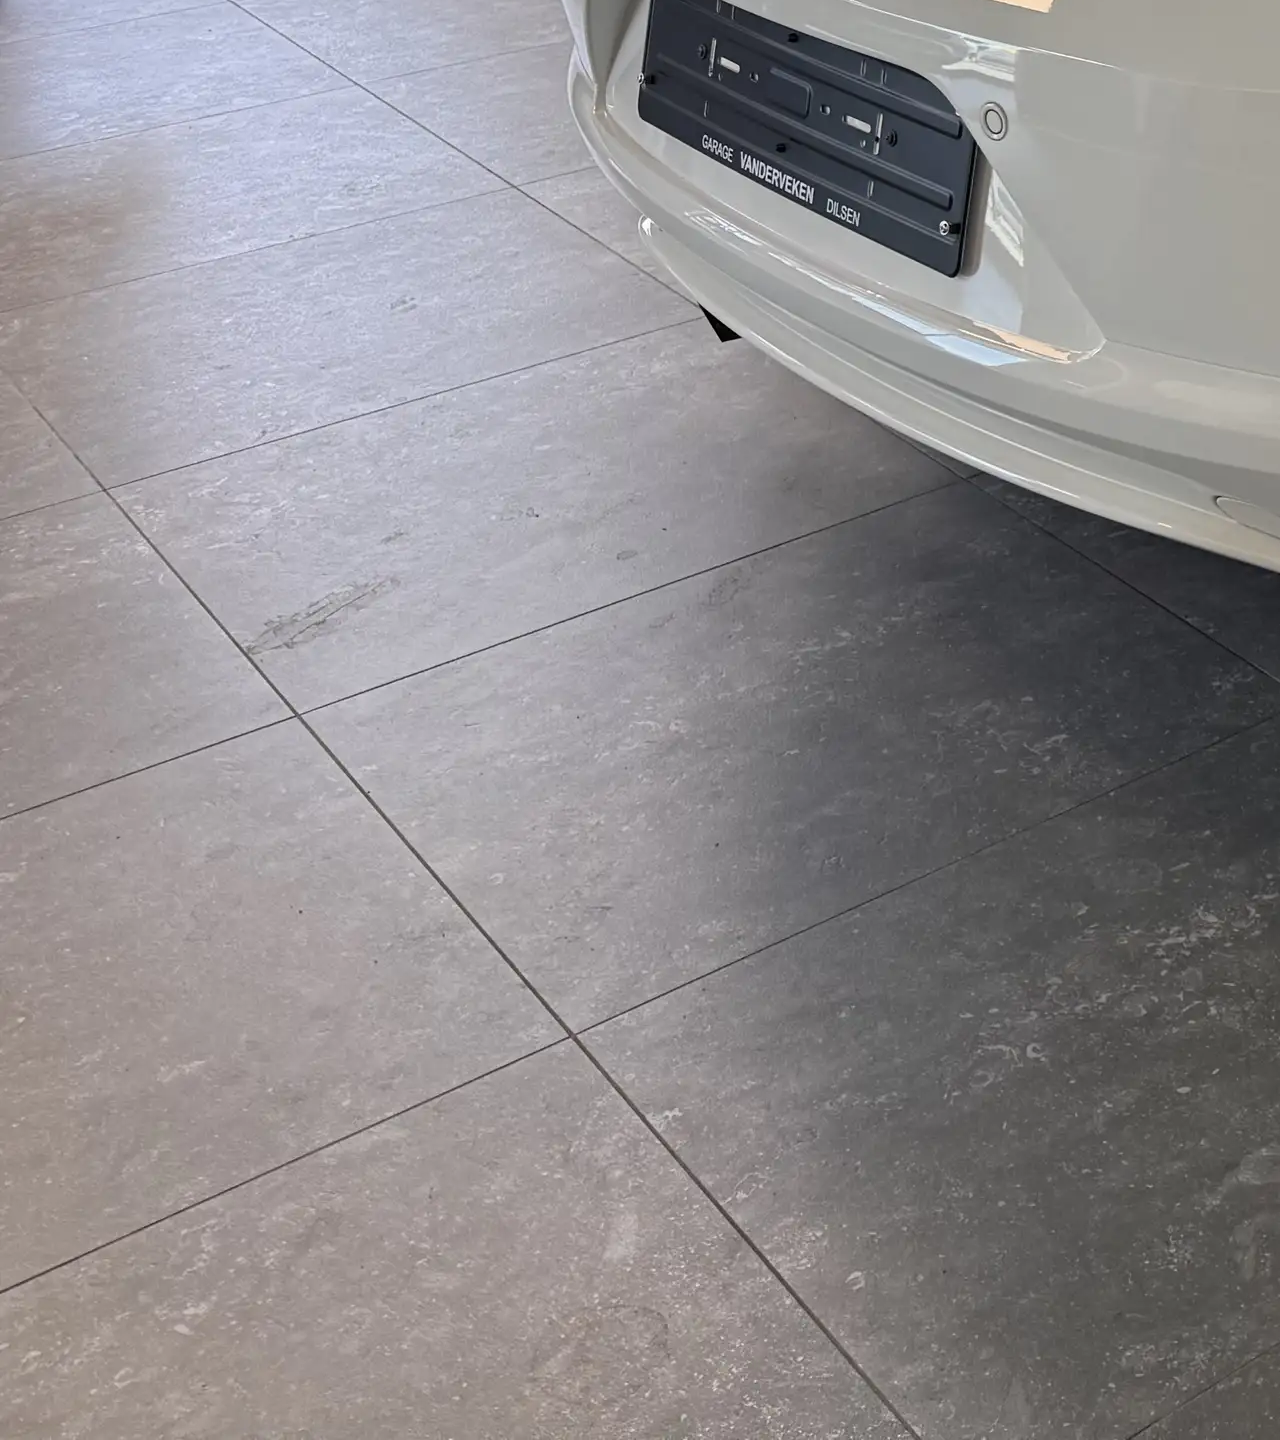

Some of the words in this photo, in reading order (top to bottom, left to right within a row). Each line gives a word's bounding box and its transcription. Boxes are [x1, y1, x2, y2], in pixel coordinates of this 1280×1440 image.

[701, 134, 734, 163] GARAGE
[740, 150, 815, 205] VANDERVEKEN
[826, 198, 861, 227] DILSEN
